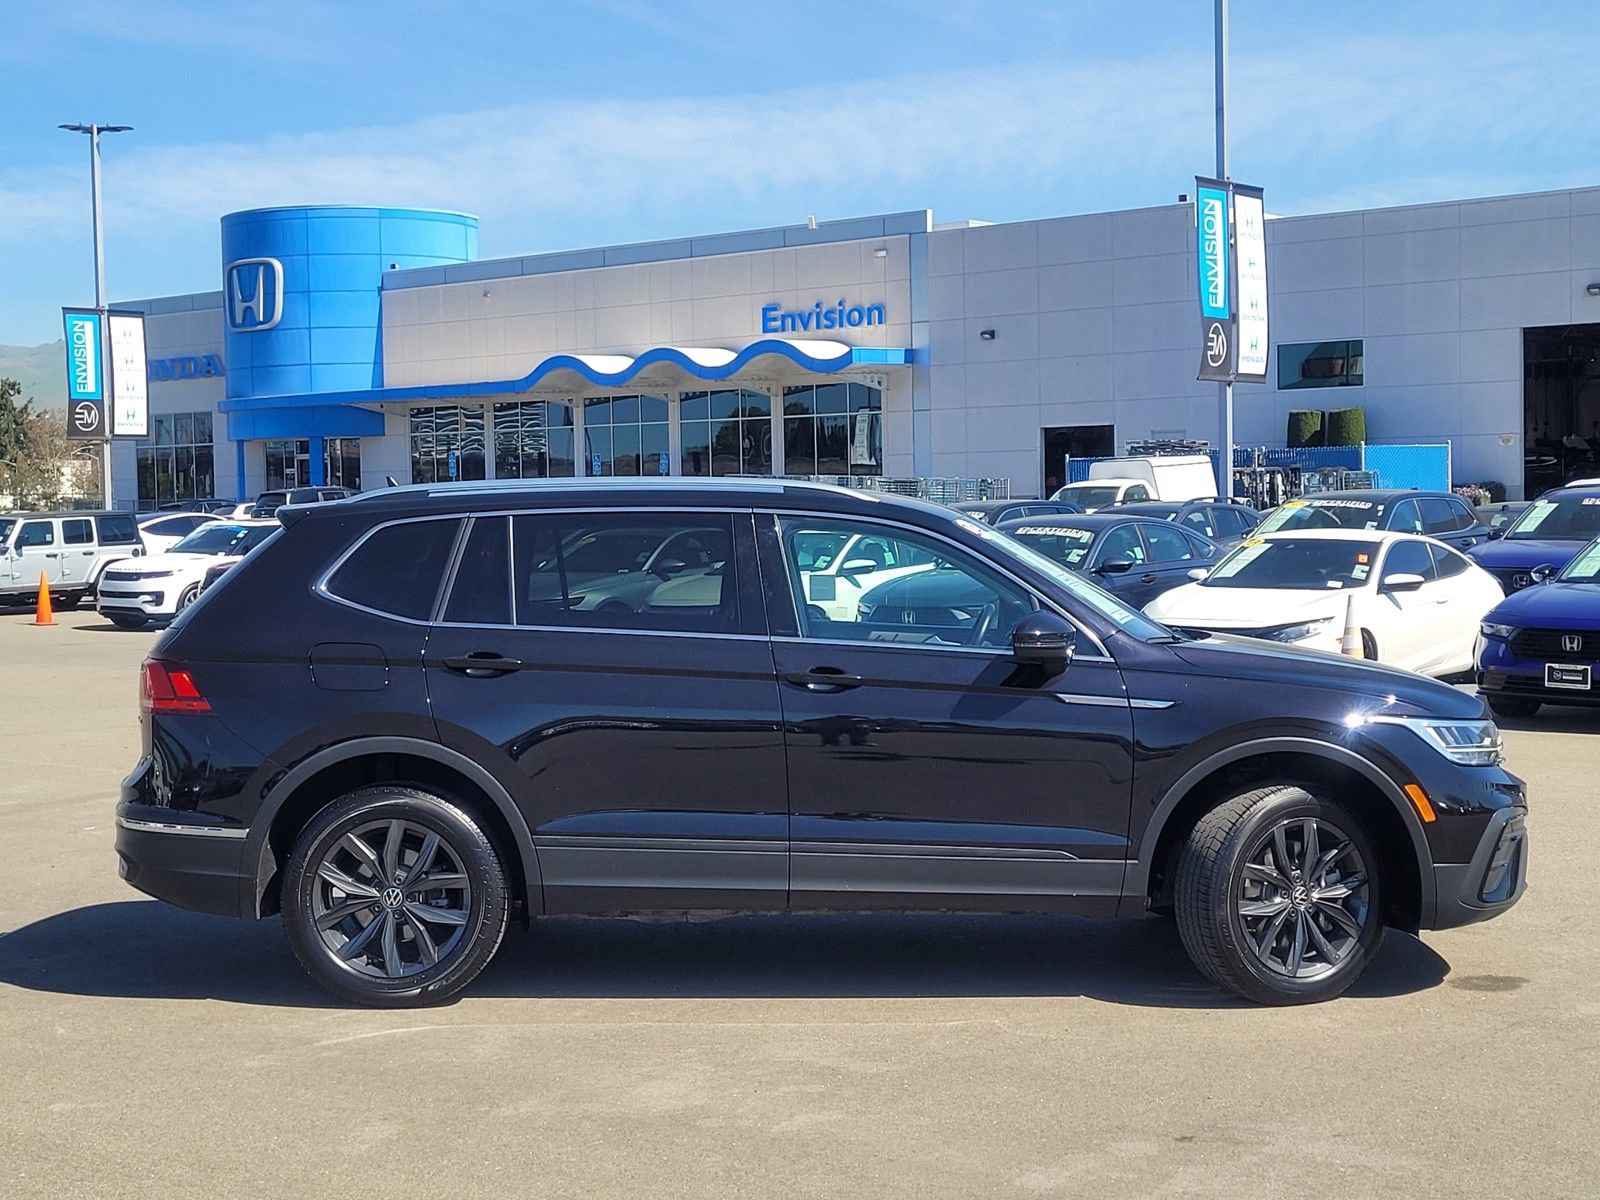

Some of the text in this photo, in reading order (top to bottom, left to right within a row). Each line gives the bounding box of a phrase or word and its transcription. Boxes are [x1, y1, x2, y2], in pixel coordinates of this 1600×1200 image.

[1204, 198, 1219, 308] ENVISION
[761, 299, 885, 334] Envision
[72, 320, 88, 393] ENVISION
